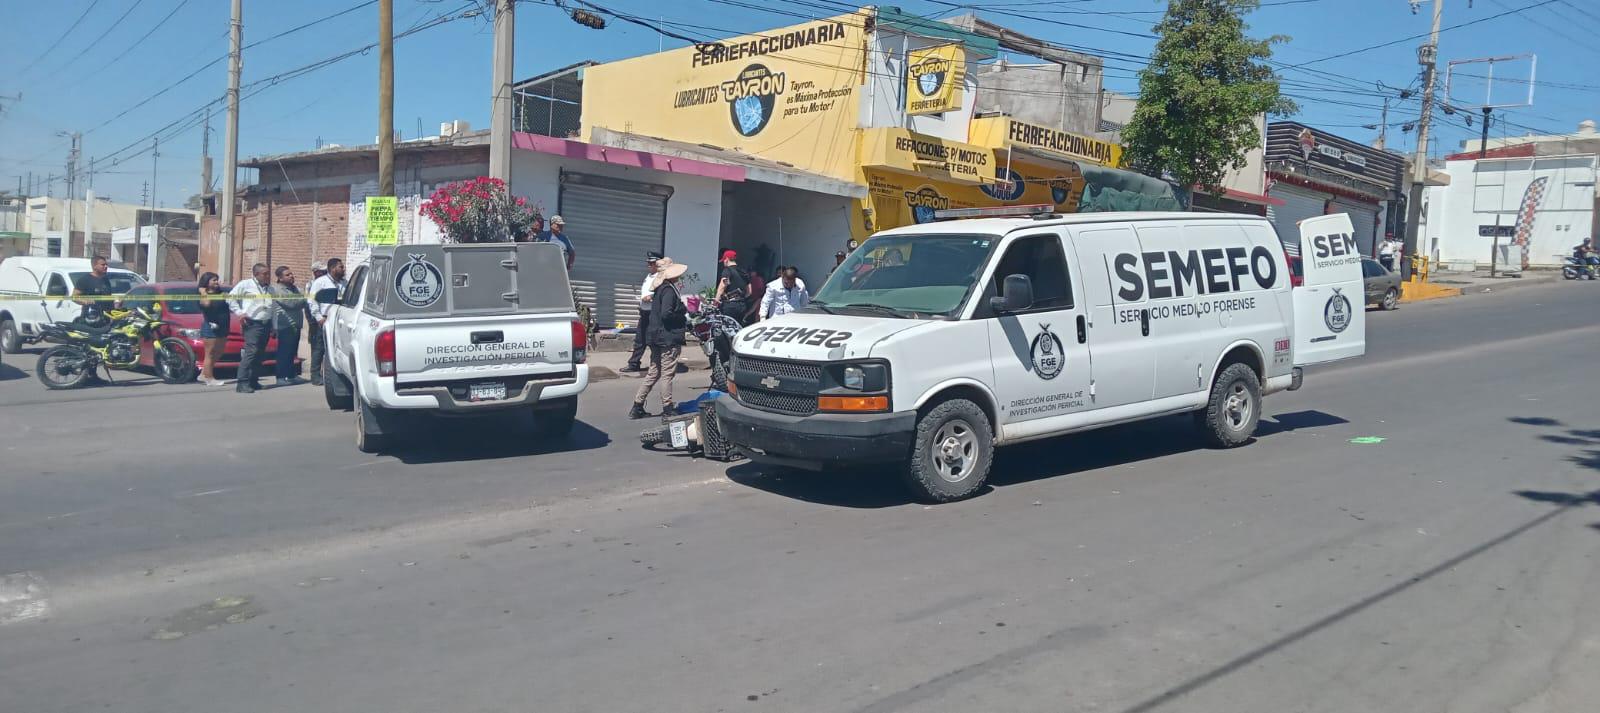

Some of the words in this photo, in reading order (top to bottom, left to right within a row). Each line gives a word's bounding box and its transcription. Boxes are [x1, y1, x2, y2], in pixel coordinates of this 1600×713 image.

[910, 60, 949, 78] TAYRON
[721, 72, 785, 102] TAYRON
[790, 81, 815, 91] Tayron,
[674, 85, 719, 108] LUBRICANTES
[786, 95, 794, 105] es
[783, 107, 799, 119] para
[799, 104, 809, 115] tu
[911, 98, 947, 111] FERRETERIA
[1009, 120, 1112, 163] FERREFACCIONARIA
[896, 136, 949, 159] REFACCIONES
[958, 149, 988, 166] MOTOS
[905, 191, 949, 210] TAYRON
[1114, 245, 1277, 302] SEMEFO
[409, 286, 430, 295] FGE
[1119, 307, 1170, 324] SERICIO
[1213, 297, 1256, 313] FORENSE
[426, 342, 482, 355] DIRECCIÓN
[484, 341, 530, 351] GENERAL
[532, 340, 545, 349] DE
[424, 351, 502, 365] INVESTIGACIÓN
[504, 350, 548, 361] PERICIAL
[1041, 357, 1057, 367] FGE
[1045, 392, 1073, 403] GENERAL
[1074, 390, 1084, 398] DE
[1057, 399, 1084, 409] PERICIAL
